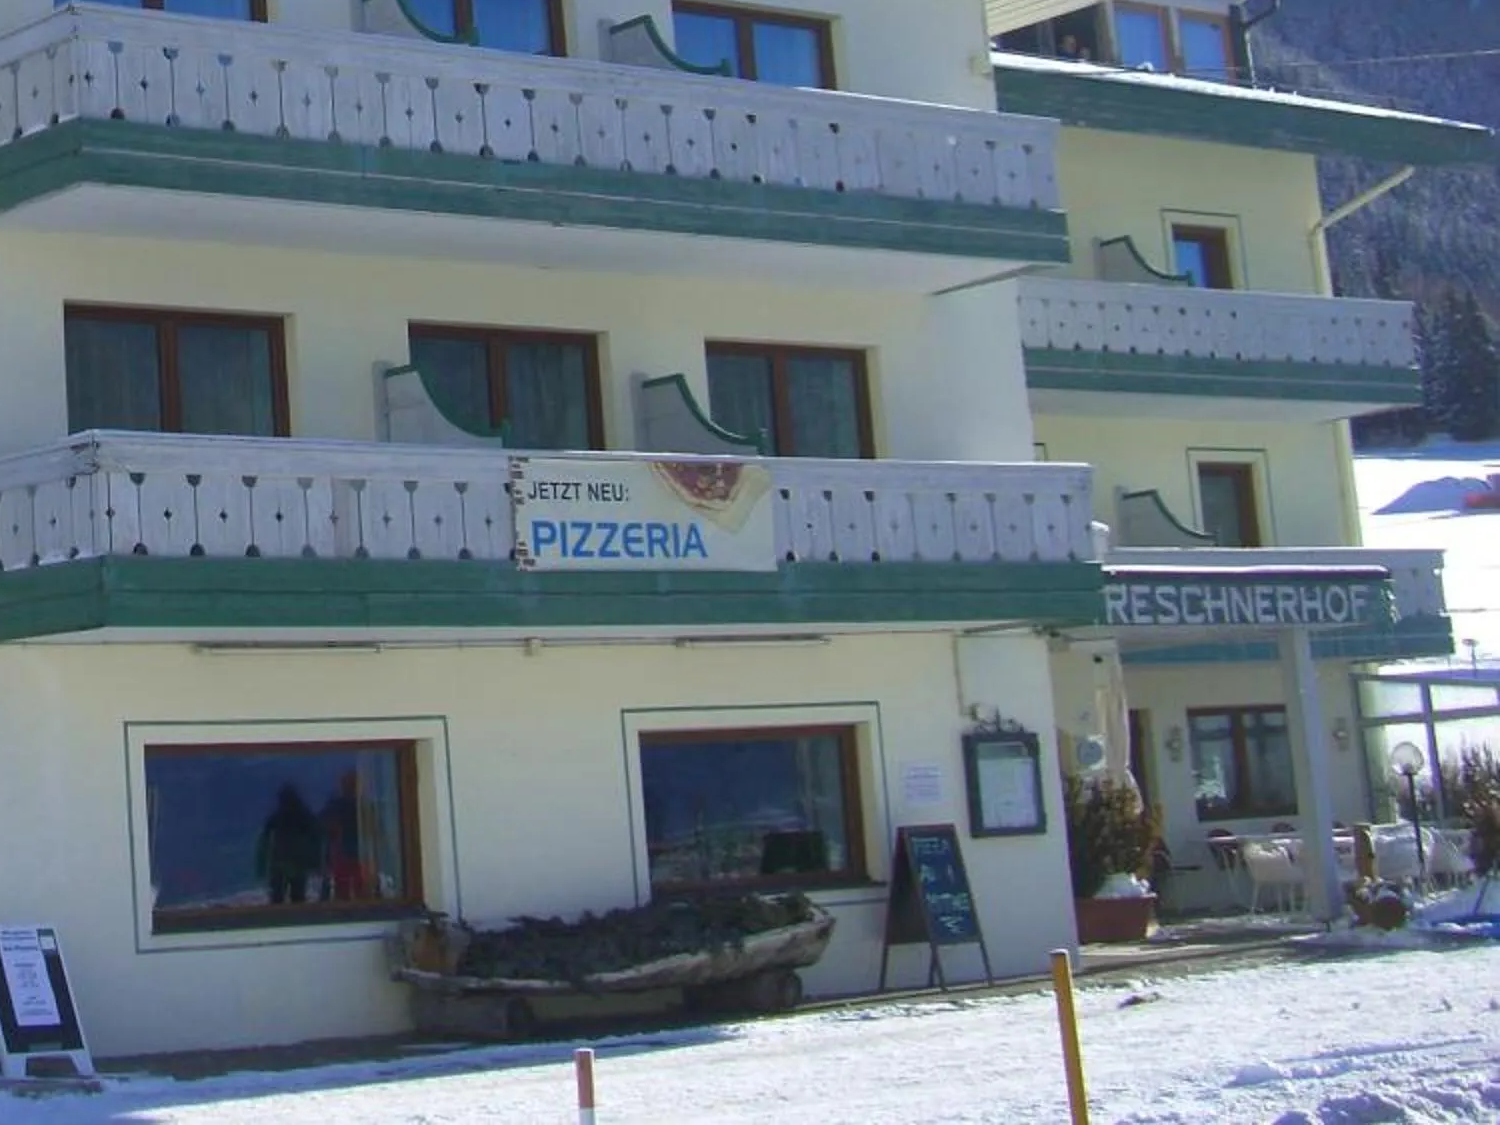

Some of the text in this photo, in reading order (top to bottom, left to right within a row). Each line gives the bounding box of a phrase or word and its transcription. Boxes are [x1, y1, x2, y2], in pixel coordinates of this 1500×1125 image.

[527, 481, 629, 502] JETZT NEU:
[531, 520, 708, 559] PIZZERIA
[1104, 583, 1371, 625] RESCHNERHOF
